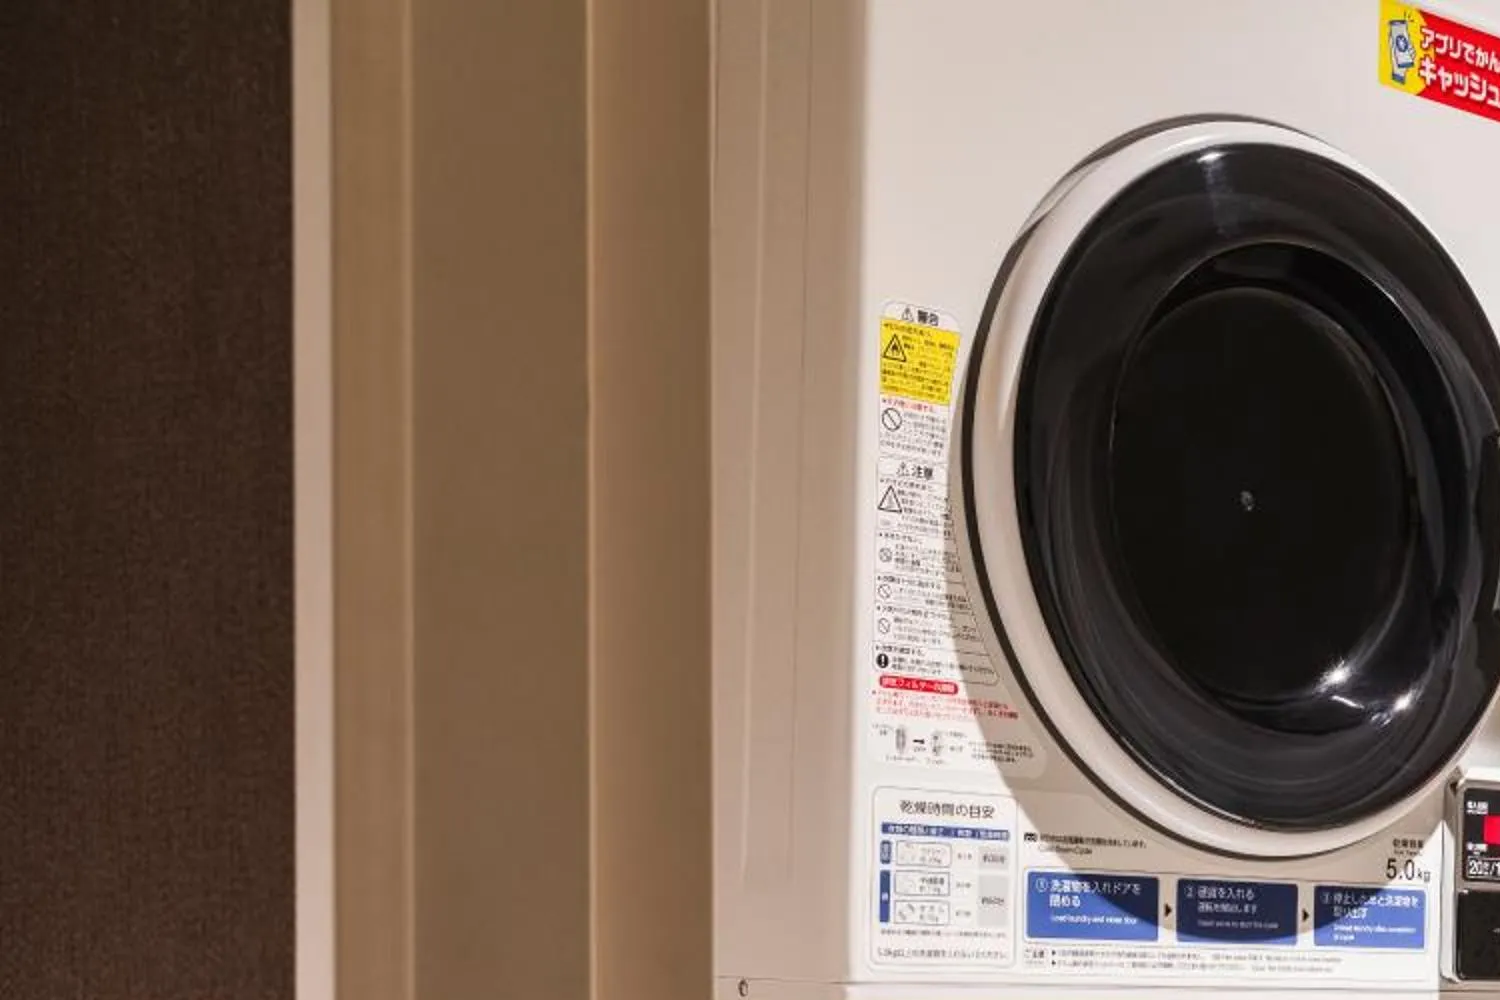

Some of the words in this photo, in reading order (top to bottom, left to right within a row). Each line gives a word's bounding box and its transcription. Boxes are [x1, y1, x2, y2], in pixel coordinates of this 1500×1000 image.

[900, 800, 995, 819] 乾燥時間の目安
